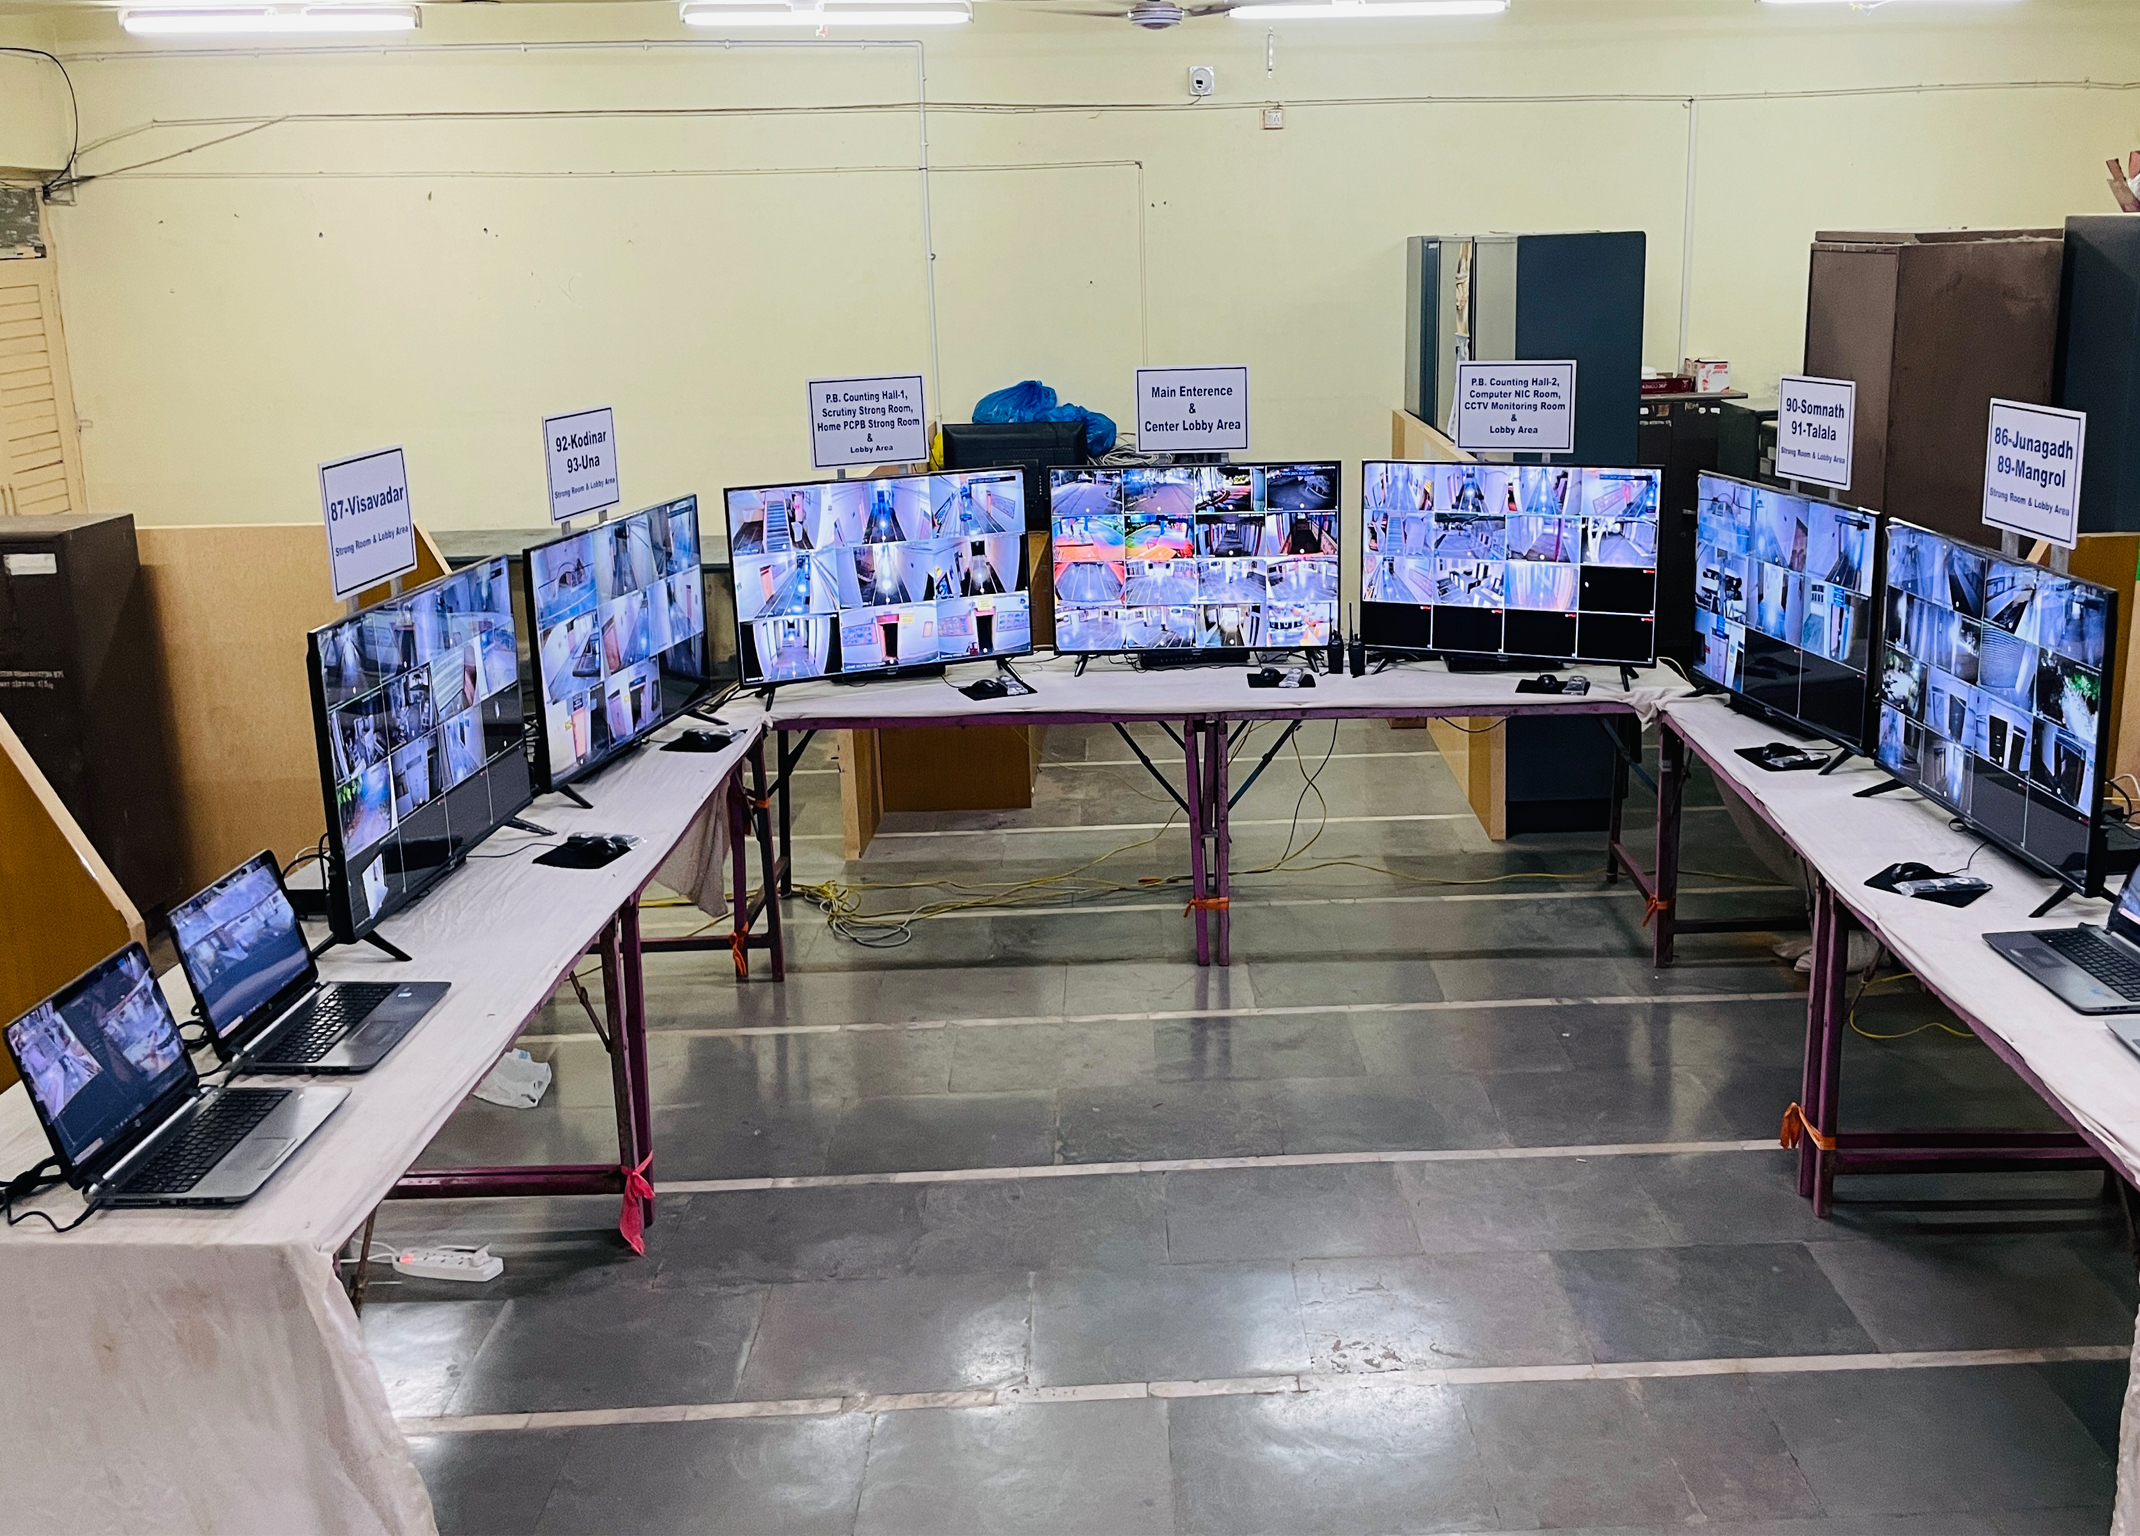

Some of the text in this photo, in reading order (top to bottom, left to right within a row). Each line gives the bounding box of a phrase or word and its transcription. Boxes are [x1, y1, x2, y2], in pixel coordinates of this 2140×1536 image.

[1471, 378, 1559, 387] P.B. Counting Hall-2,
[826, 390, 908, 403] P.B. Counting Hall-1,
[1152, 386, 1232, 397] Main Enterence
[1470, 390, 1511, 399] Computer
[1534, 390, 1560, 399] Room,
[822, 405, 913, 417] Scrutiny Strong Room,
[1189, 403, 1196, 413] &
[1491, 402, 1537, 411] Monitoring
[1541, 402, 1565, 410] Room
[1786, 398, 1844, 418] 90-Somnath
[817, 418, 919, 431] Home PCPB Strong Room
[1145, 419, 1240, 433] Center Lobby Area
[1490, 426, 1515, 435] Lobby
[1792, 421, 1836, 440] 91-Talala
[556, 431, 606, 452] 92-Kodinar
[867, 433, 873, 442] &
[1995, 427, 2073, 459] 86-Junagadh
[1781, 447, 1796, 457] Strong
[1817, 452, 1832, 463] Lobby
[567, 455, 600, 473] 93-Una
[1998, 456, 2065, 488] 89-Mangrol
[555, 489, 570, 499] Strong
[572, 485, 584, 494] Room
[591, 480, 603, 489] Lobby
[330, 486, 404, 521] 87-Visavadar
[1990, 487, 2069, 516] Strong Room & Lobby Area
[336, 525, 408, 556] Strong Room & Lobby Area
